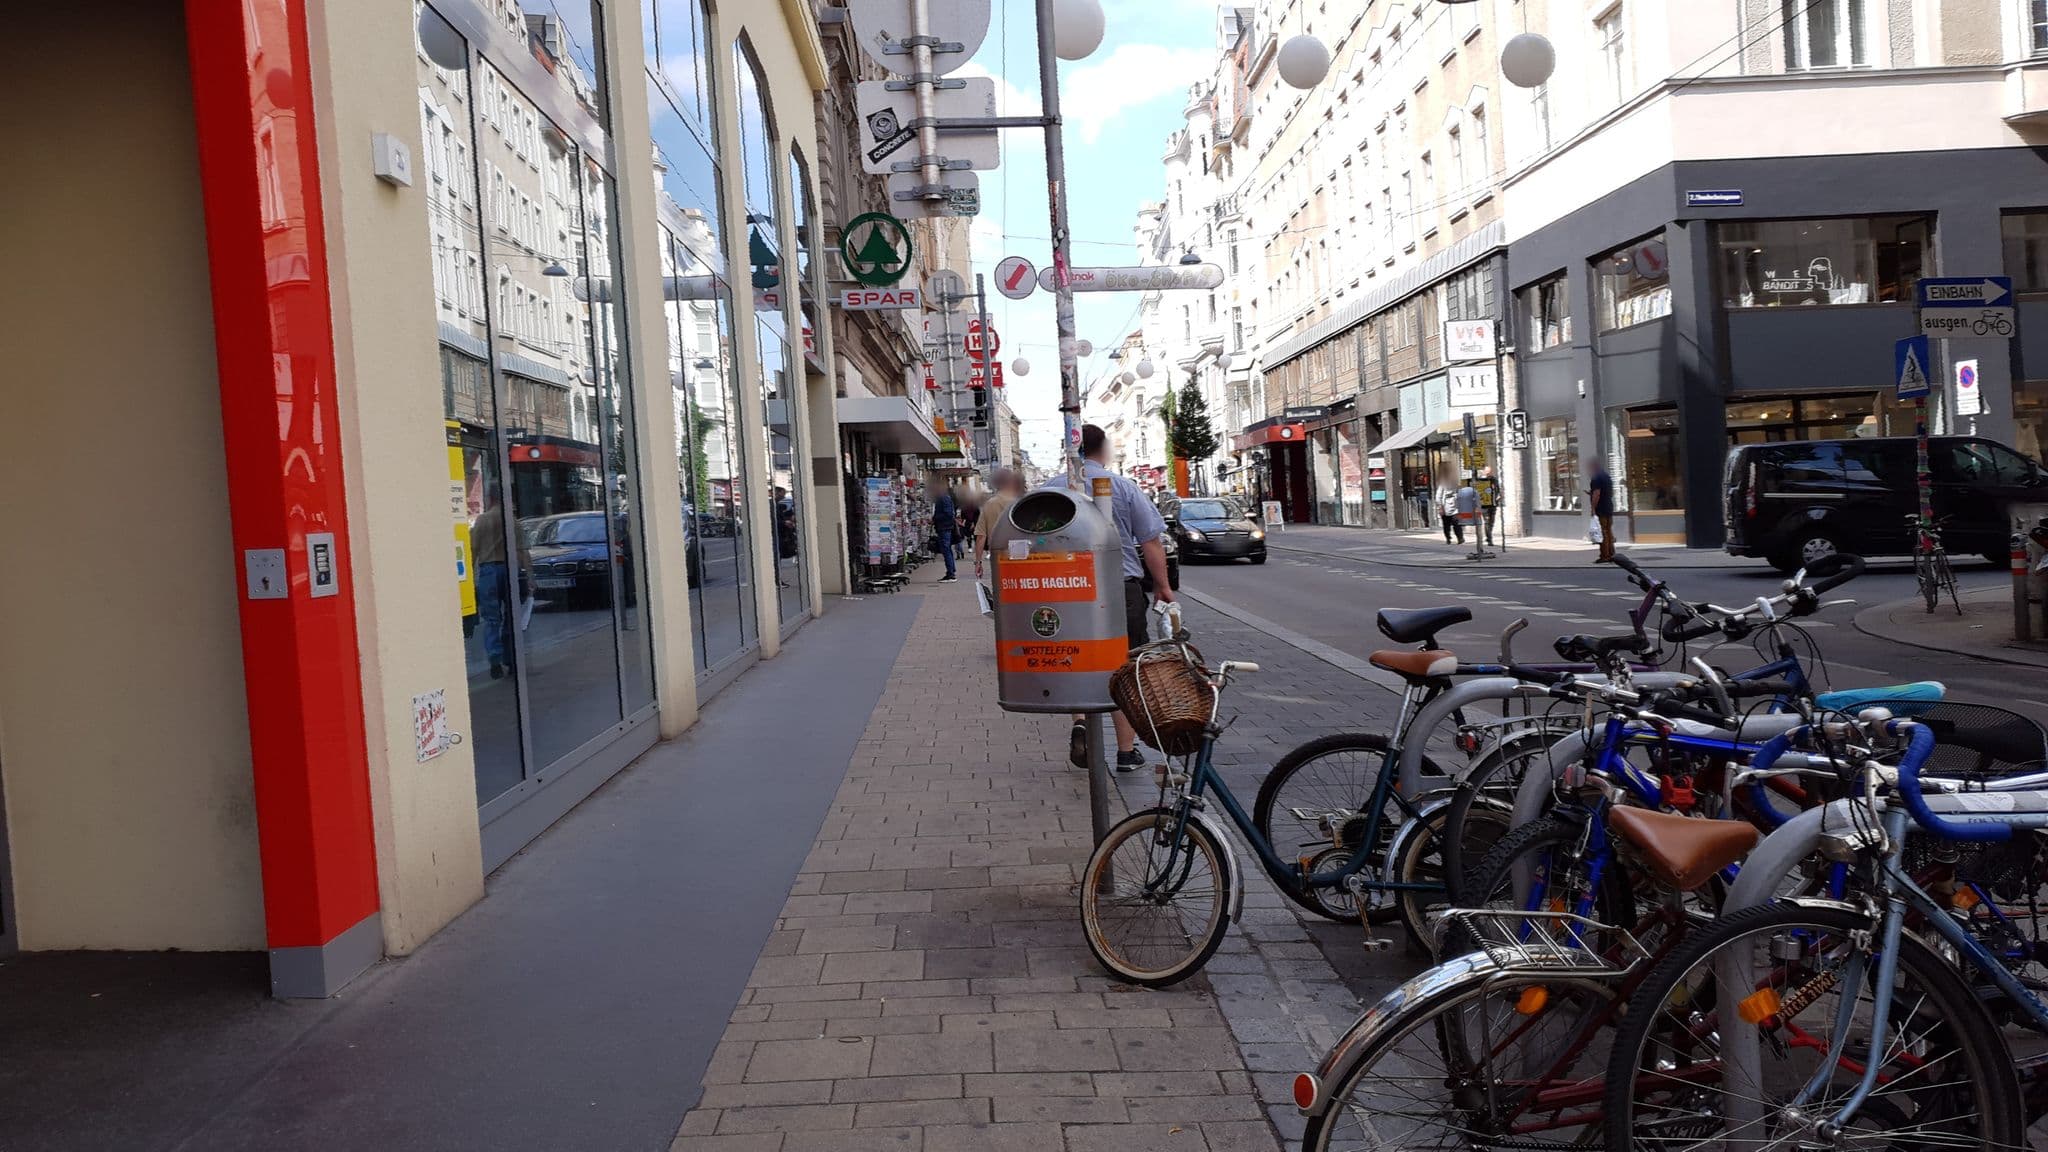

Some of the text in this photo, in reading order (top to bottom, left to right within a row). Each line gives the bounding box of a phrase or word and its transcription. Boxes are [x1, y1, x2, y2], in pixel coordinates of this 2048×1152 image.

[847, 292, 915, 305] SPAR
[1930, 286, 1983, 299] EINBAHN
[1925, 318, 1972, 331] ausgen.
[1020, 578, 1040, 589] NED
[1042, 576, 1092, 589] HAGLICH.
